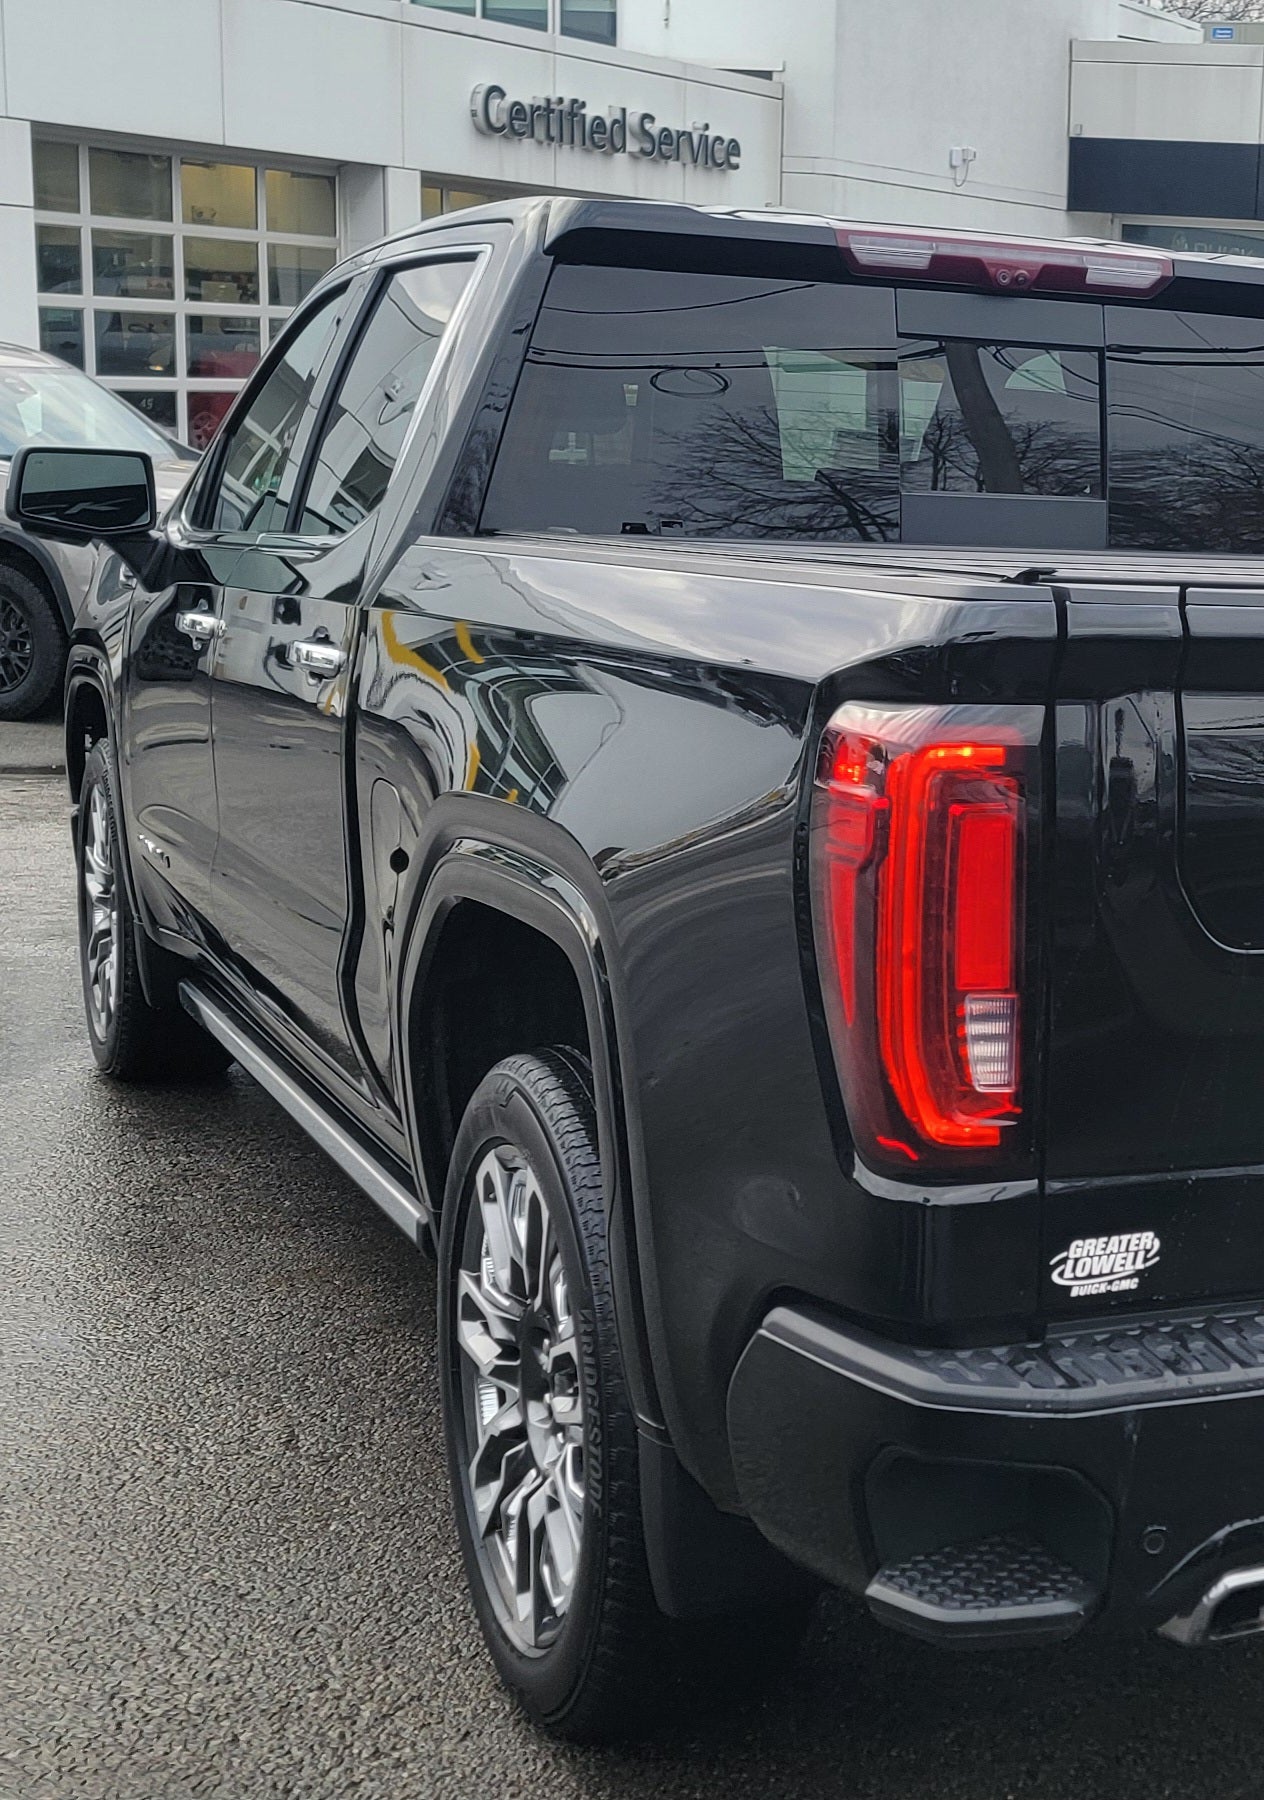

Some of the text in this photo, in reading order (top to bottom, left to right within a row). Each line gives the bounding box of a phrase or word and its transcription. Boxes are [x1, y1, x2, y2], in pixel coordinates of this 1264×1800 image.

[470, 83, 741, 170] Certified Service
[1063, 1250, 1146, 1279] LOWELL
[1068, 1231, 1155, 1259] GREATER
[577, 1308, 603, 1518] BRIDGESTONE
